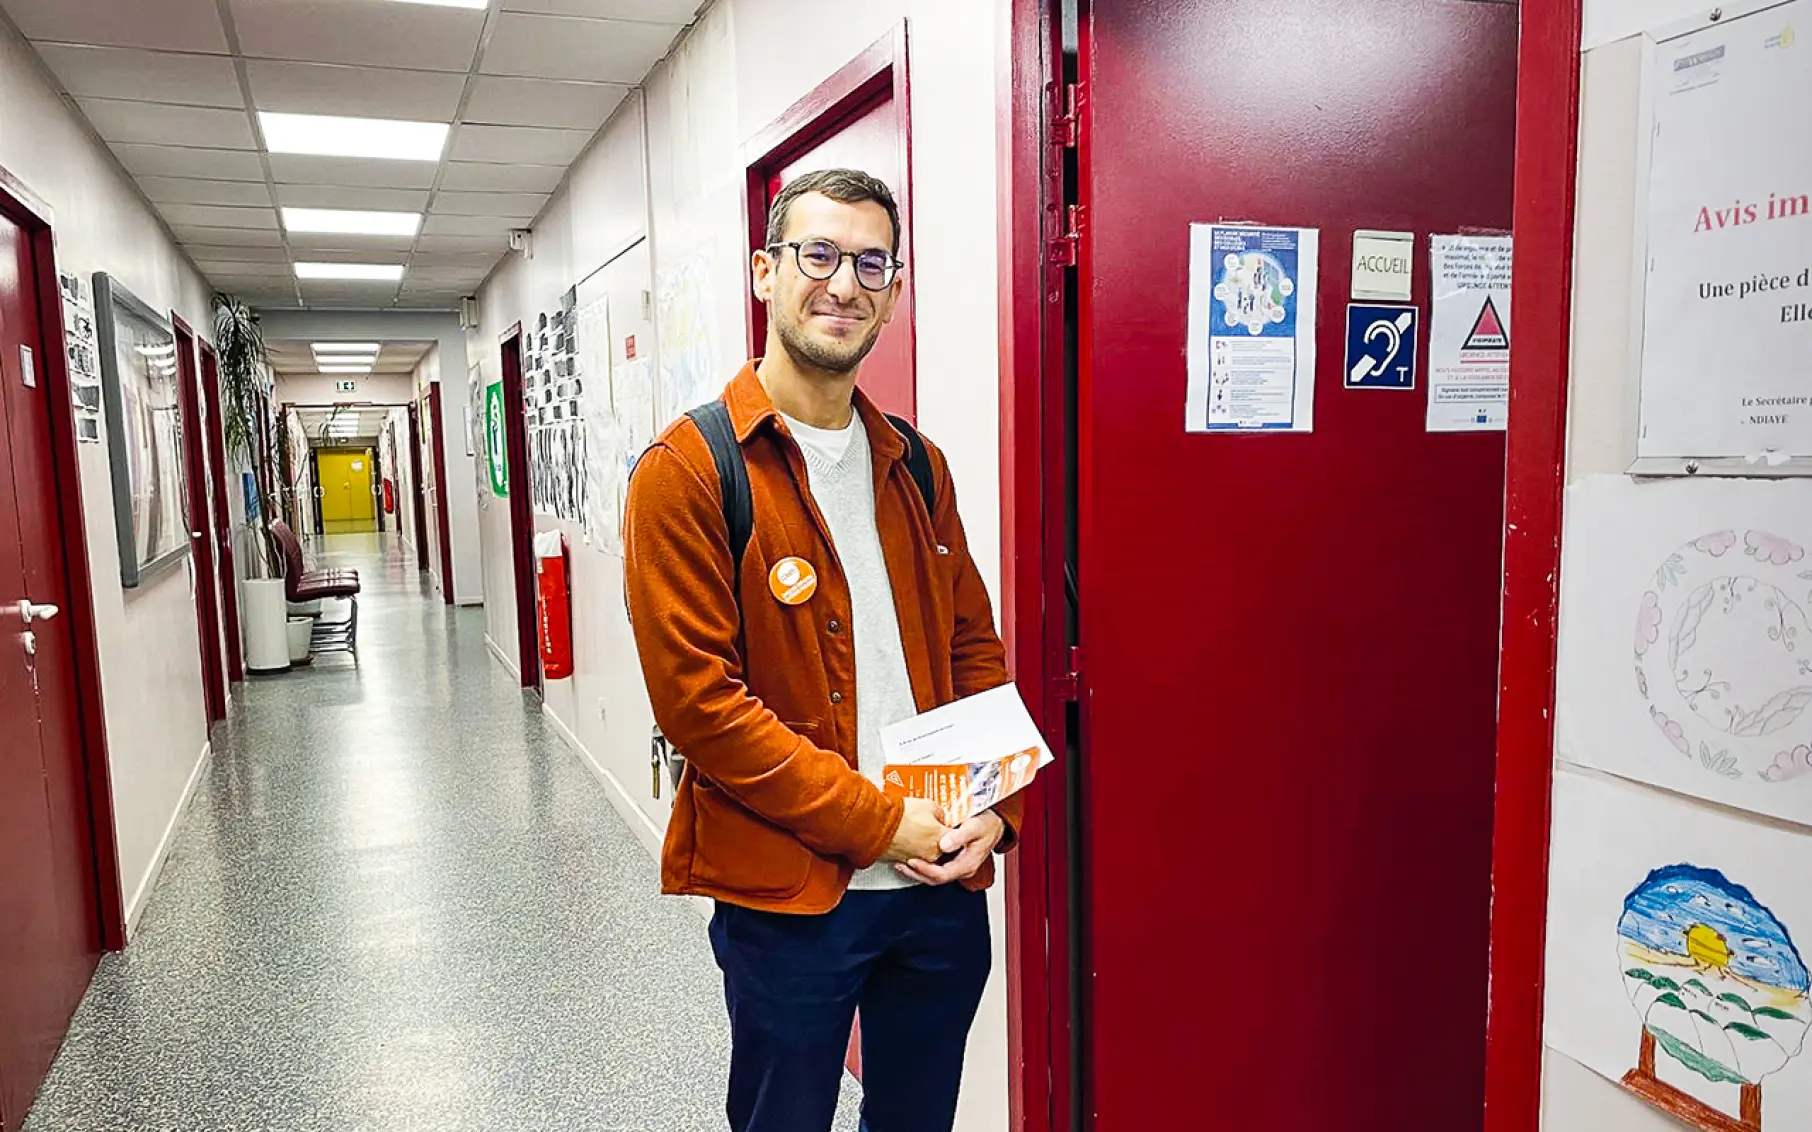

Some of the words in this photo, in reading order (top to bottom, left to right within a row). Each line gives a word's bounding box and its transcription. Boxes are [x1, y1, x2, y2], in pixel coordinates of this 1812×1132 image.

[1694, 200, 1757, 233] Avis
[1767, 192, 1809, 220] im
[1356, 256, 1409, 274] ACCUEIL
[1700, 282, 1735, 299] Une
[1739, 272, 1790, 299] pièce
[1396, 366, 1409, 382] T
[1742, 398, 1753, 406] Le
[1755, 396, 1807, 406] Secrétaire
[1750, 414, 1789, 424] NDIAYE
